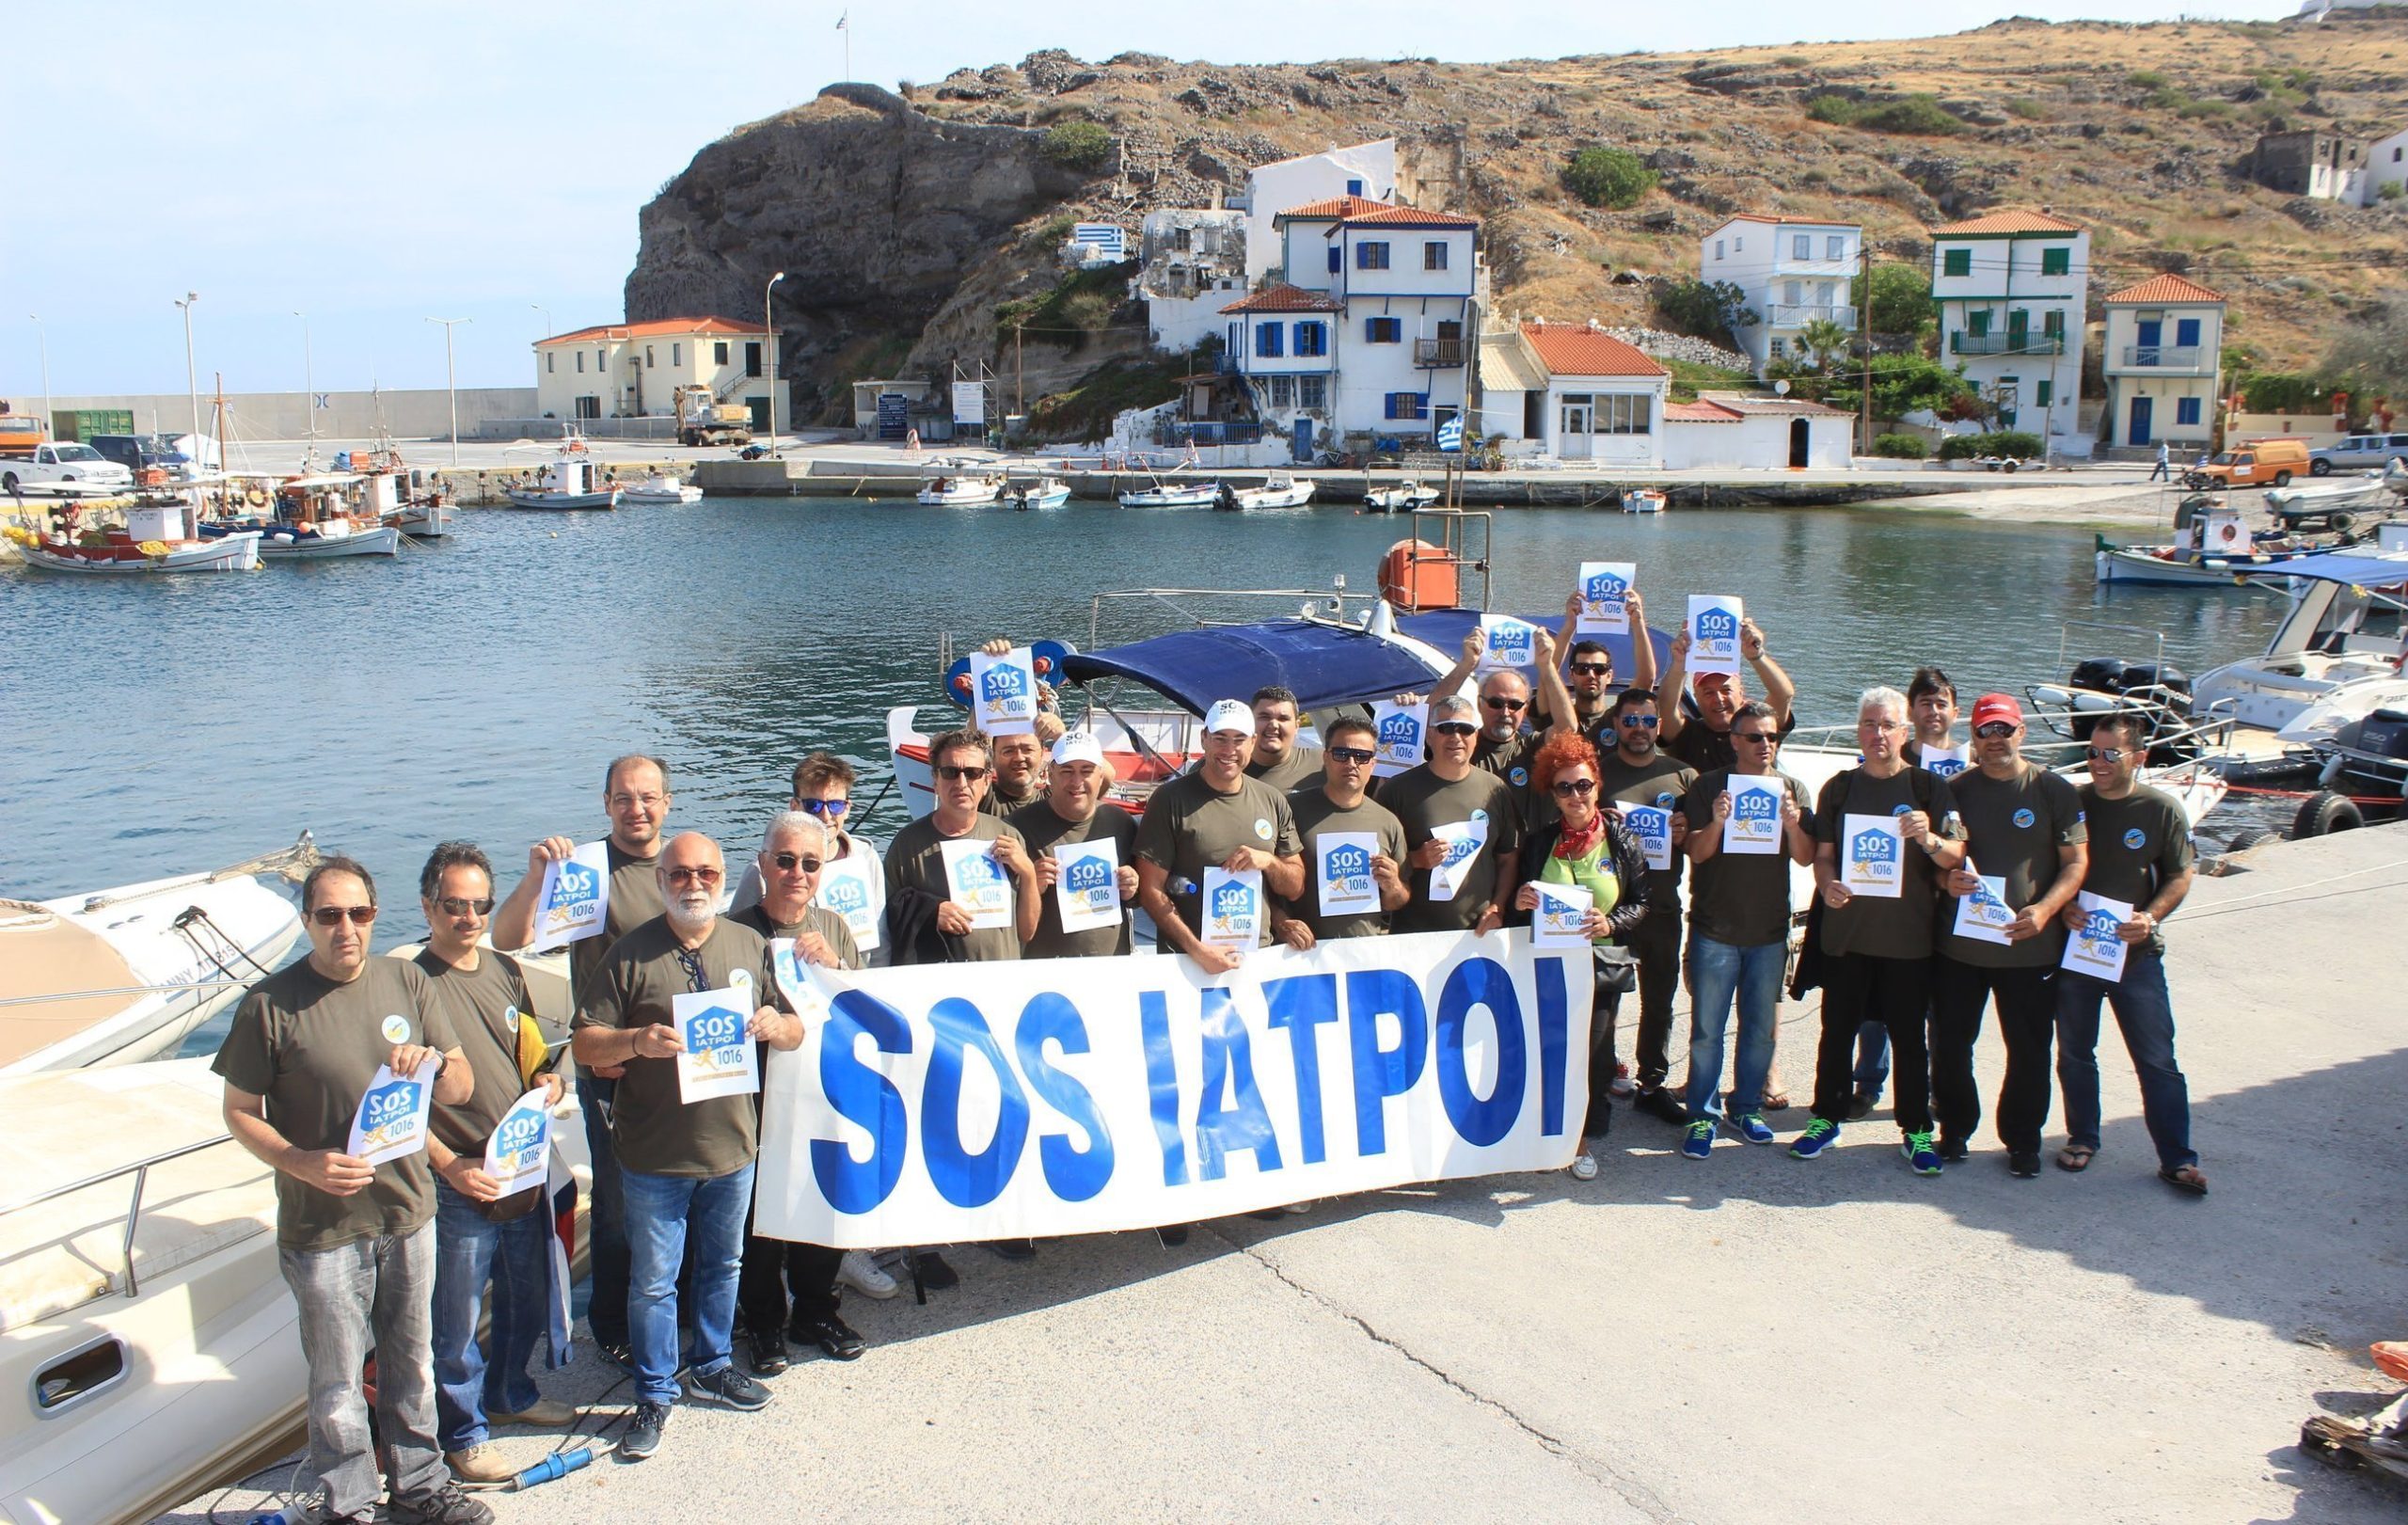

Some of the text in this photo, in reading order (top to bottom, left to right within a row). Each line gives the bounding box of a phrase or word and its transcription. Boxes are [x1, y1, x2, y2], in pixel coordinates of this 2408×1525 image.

[1592, 579, 1621, 593] SOS
[1604, 603, 1621, 613] 1016
[1702, 614, 1731, 630] SOS
[1495, 627, 1524, 640] SOS
[1715, 641, 1732, 652] 1016
[1509, 651, 1526, 662] 1016
[988, 671, 1021, 690] SOS
[1006, 700, 1026, 712] 1016
[1385, 720, 1414, 736] SOS
[1395, 746, 1413, 758] 1016
[1933, 763, 1961, 777] SOS
[1740, 795, 1771, 810] SOS
[1631, 813, 1660, 828] SOS
[1754, 821, 1772, 833] 1016
[1644, 838, 1662, 850] 1016
[1858, 836, 1890, 851] SOS
[1331, 850, 1362, 868] SOS
[960, 860, 994, 878] SOS
[1072, 862, 1105, 881] SOS
[1873, 864, 1892, 875] 1016
[553, 870, 592, 893] SOS
[1349, 879, 1369, 890] 1016
[831, 882, 861, 902] SOS
[982, 890, 1001, 903] 1016
[1090, 889, 1110, 902] 1016
[1218, 888, 1248, 905] SOS
[573, 903, 594, 917] 1016
[1988, 907, 2006, 921] 1016
[1233, 918, 1251, 929] 1016
[1564, 914, 1583, 926] 1016
[2087, 913, 2117, 934] SOS
[2098, 944, 2116, 958] 1016
[694, 1015, 736, 1039] SOS
[717, 1049, 743, 1065] 1016
[810, 957, 1567, 1215] SOS ΙΑΤΡΟΙ
[369, 1086, 412, 1117] SOS
[390, 1117, 415, 1137] 1016
[503, 1114, 540, 1139] SOS
[520, 1147, 540, 1166] 1016
